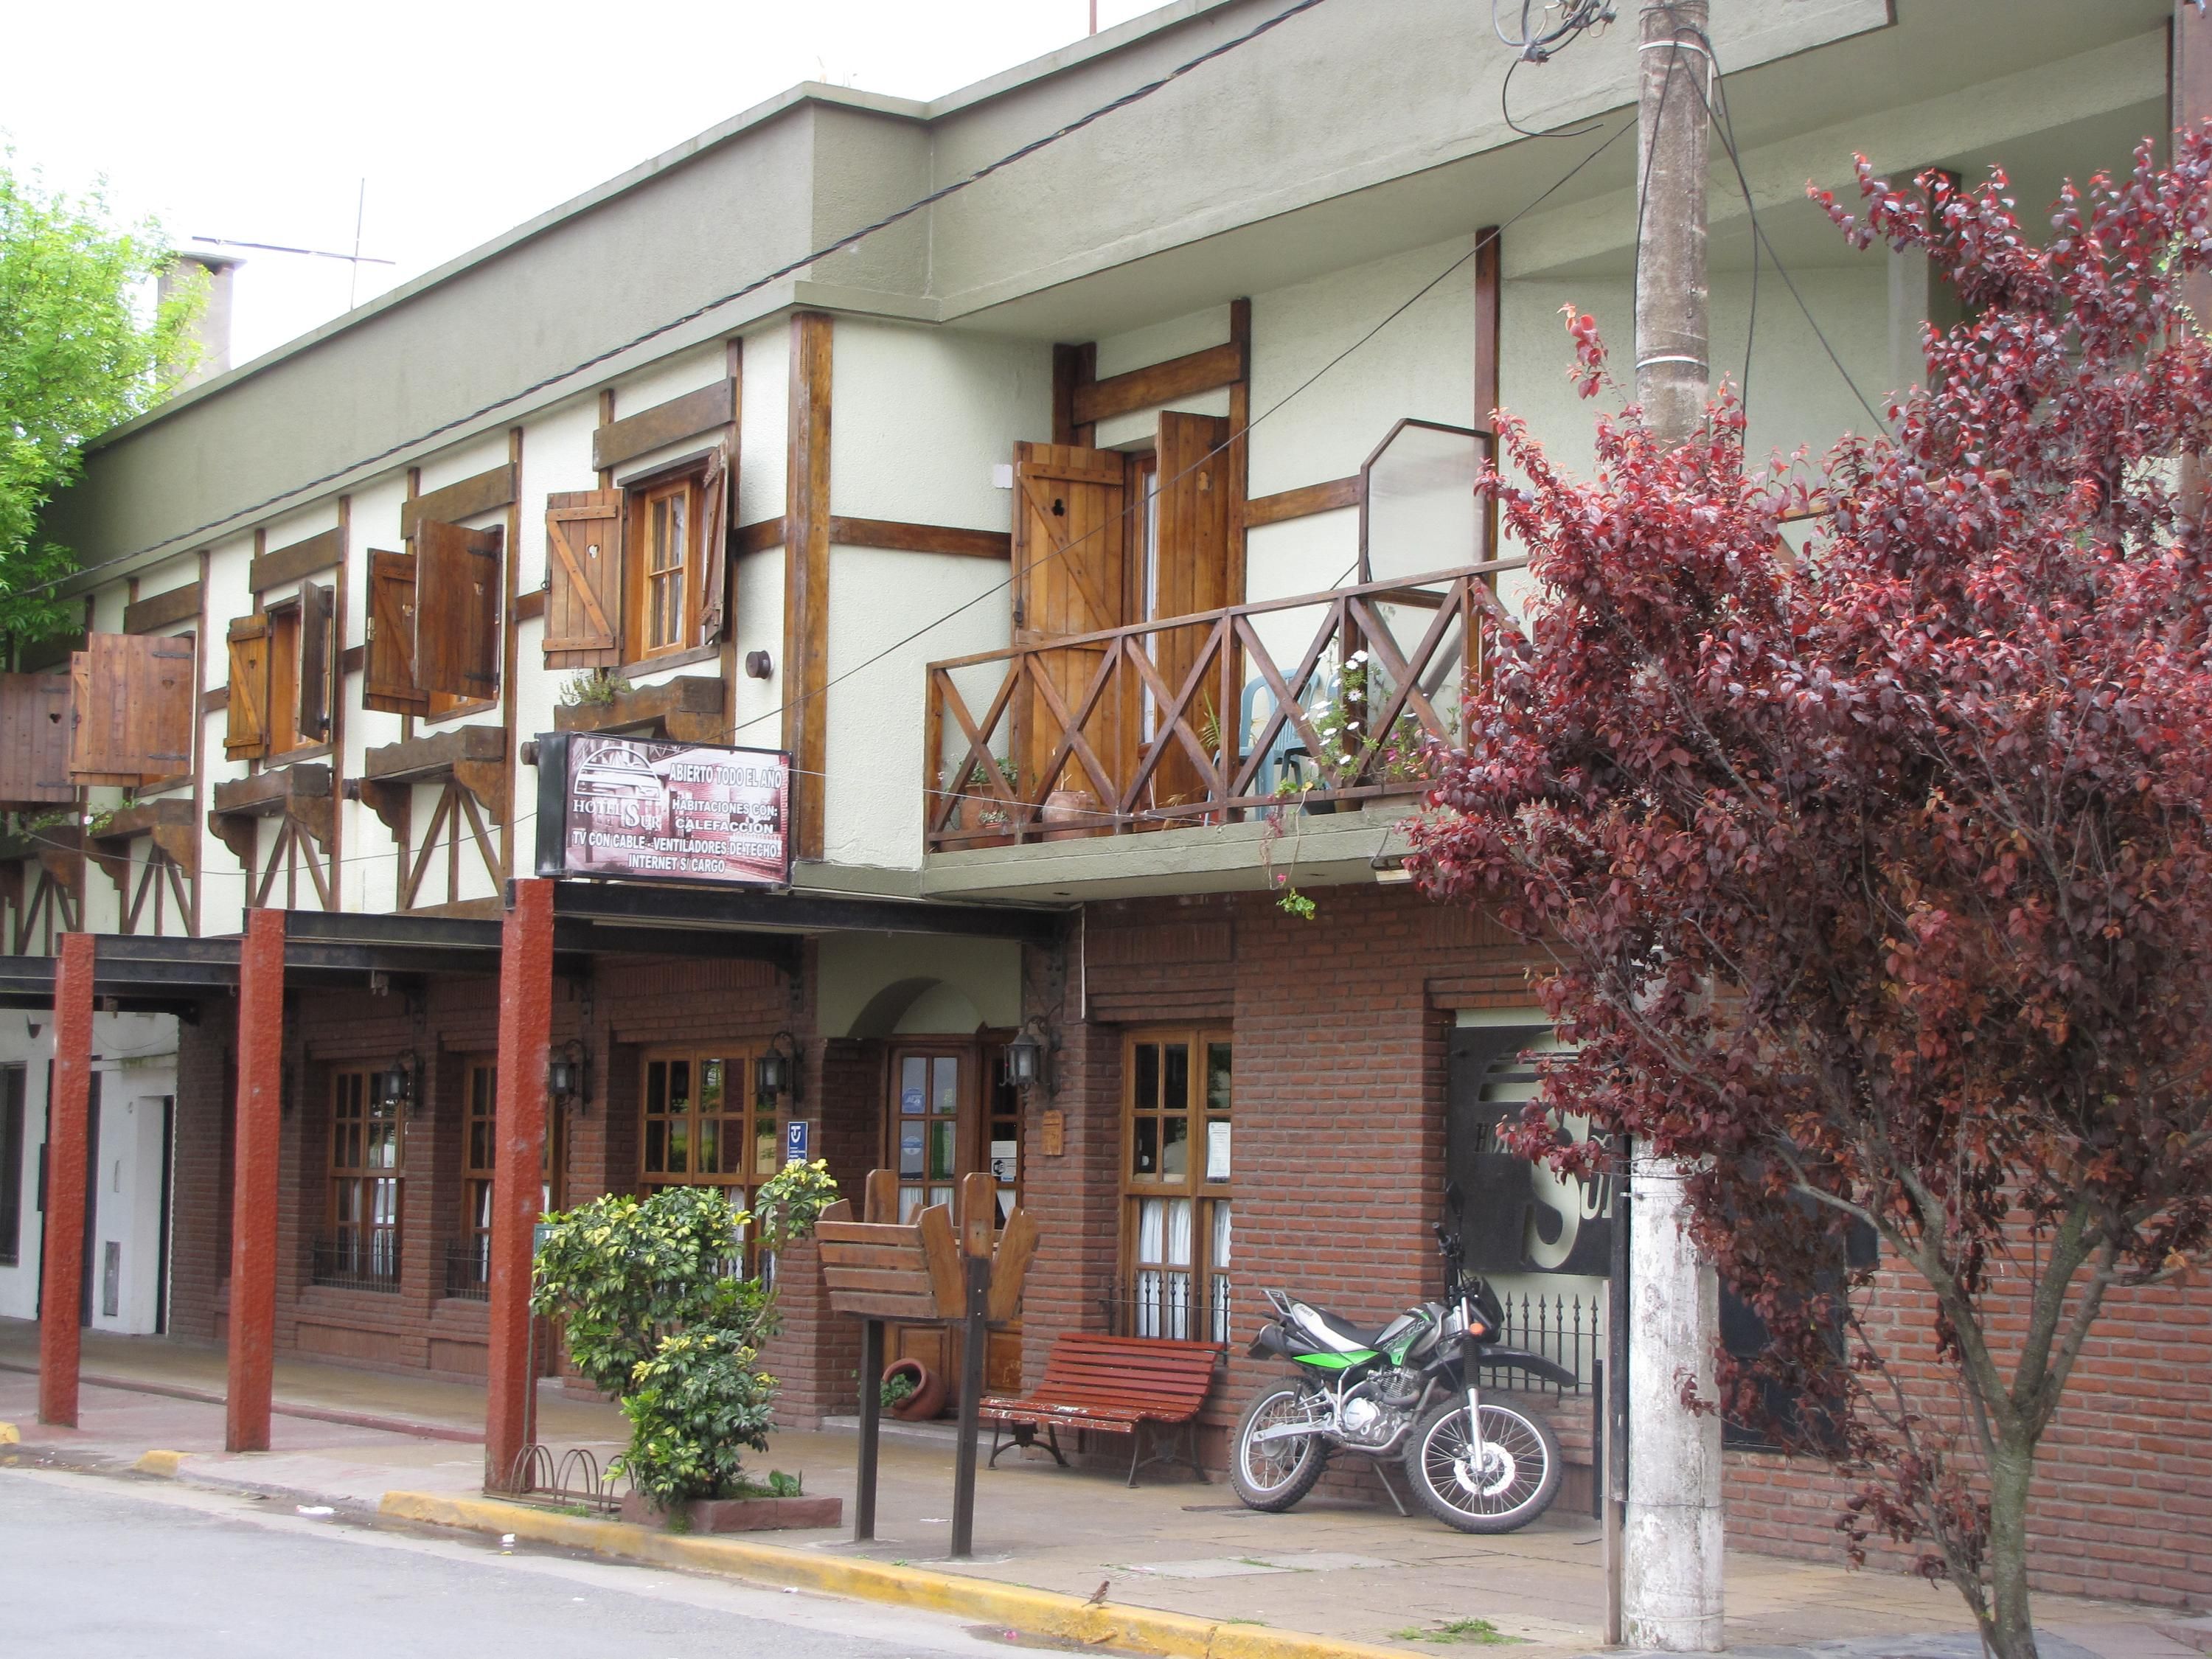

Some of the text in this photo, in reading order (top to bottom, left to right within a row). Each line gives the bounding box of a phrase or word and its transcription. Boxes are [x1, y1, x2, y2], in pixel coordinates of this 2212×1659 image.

[669, 762, 782, 789] ABIERTO TODO EL AÑO
[572, 799, 622, 816] HOTEL
[672, 798, 779, 818] HABITACIONES CON:
[572, 830, 587, 846] TV
[588, 831, 611, 847] CON
[612, 834, 646, 850] CABLE
[653, 836, 727, 856] VENTILADORES
[728, 841, 743, 857] DE
[628, 853, 726, 874] INTERNET S/ CARGO
